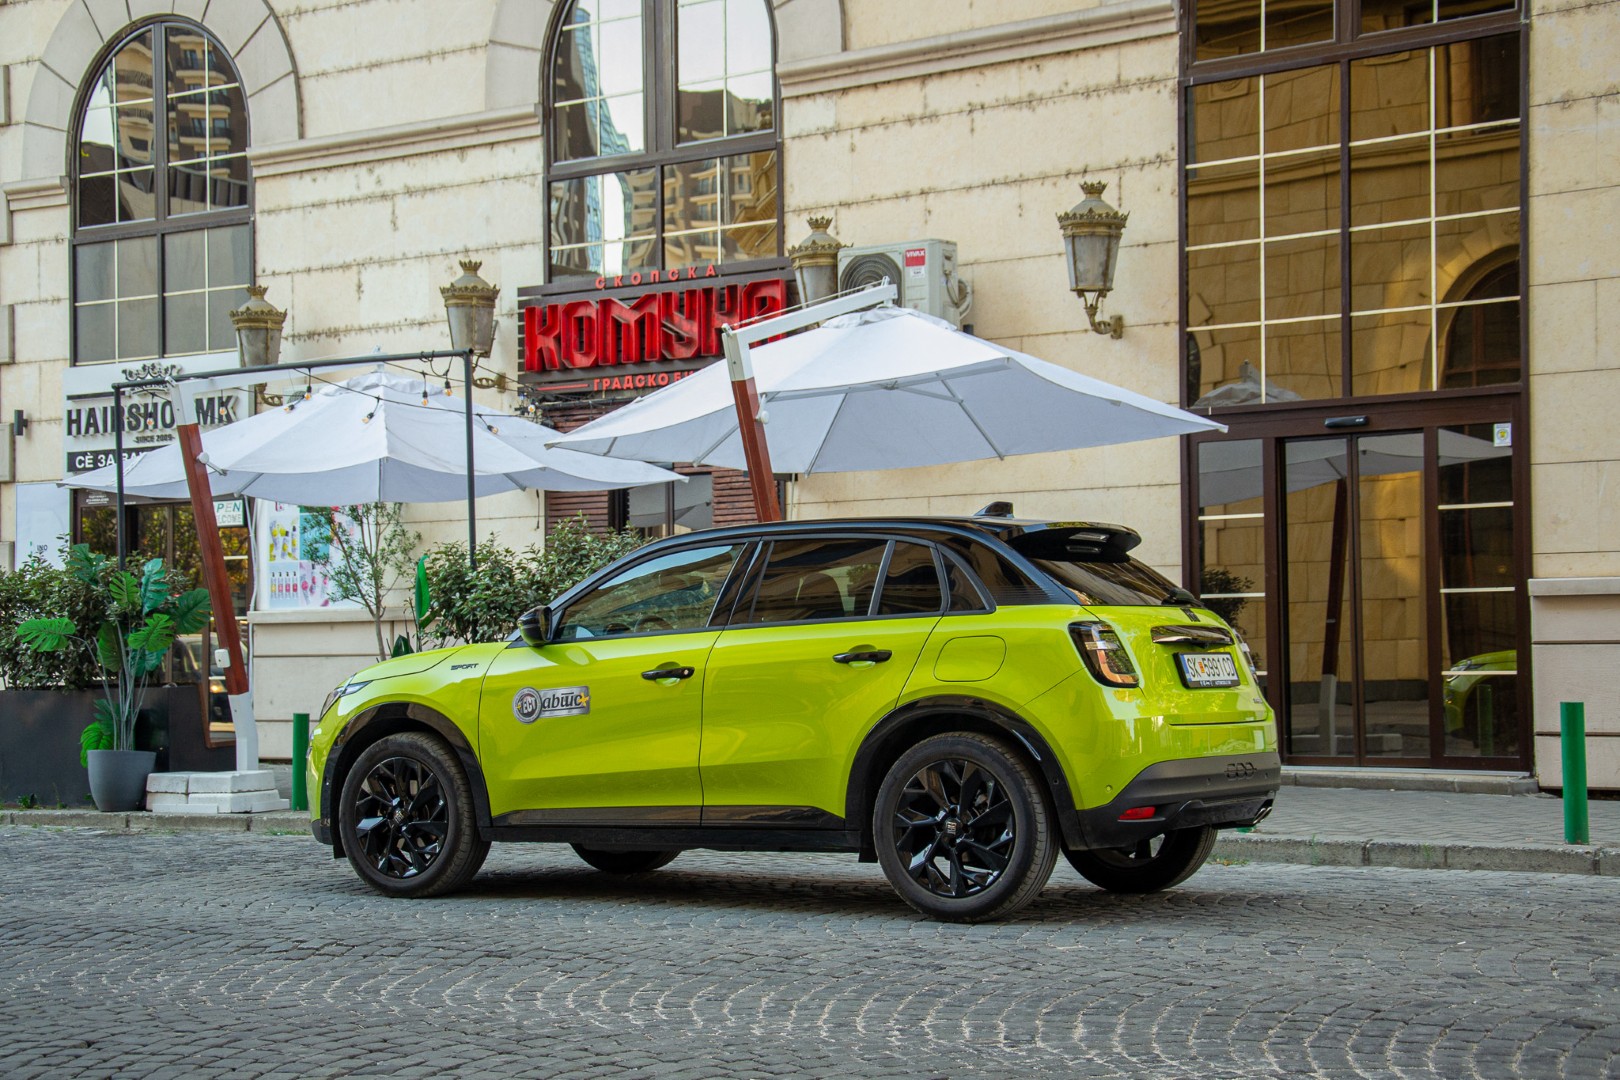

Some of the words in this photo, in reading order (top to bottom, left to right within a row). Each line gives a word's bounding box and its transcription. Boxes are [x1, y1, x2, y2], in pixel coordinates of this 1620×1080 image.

[595, 263, 716, 290] СКОПСКА
[593, 373, 670, 391] ГРАДСКО
[216, 501, 242, 513] PEN
[450, 663, 480, 671] SPORT
[1187, 657, 1201, 678] SK
